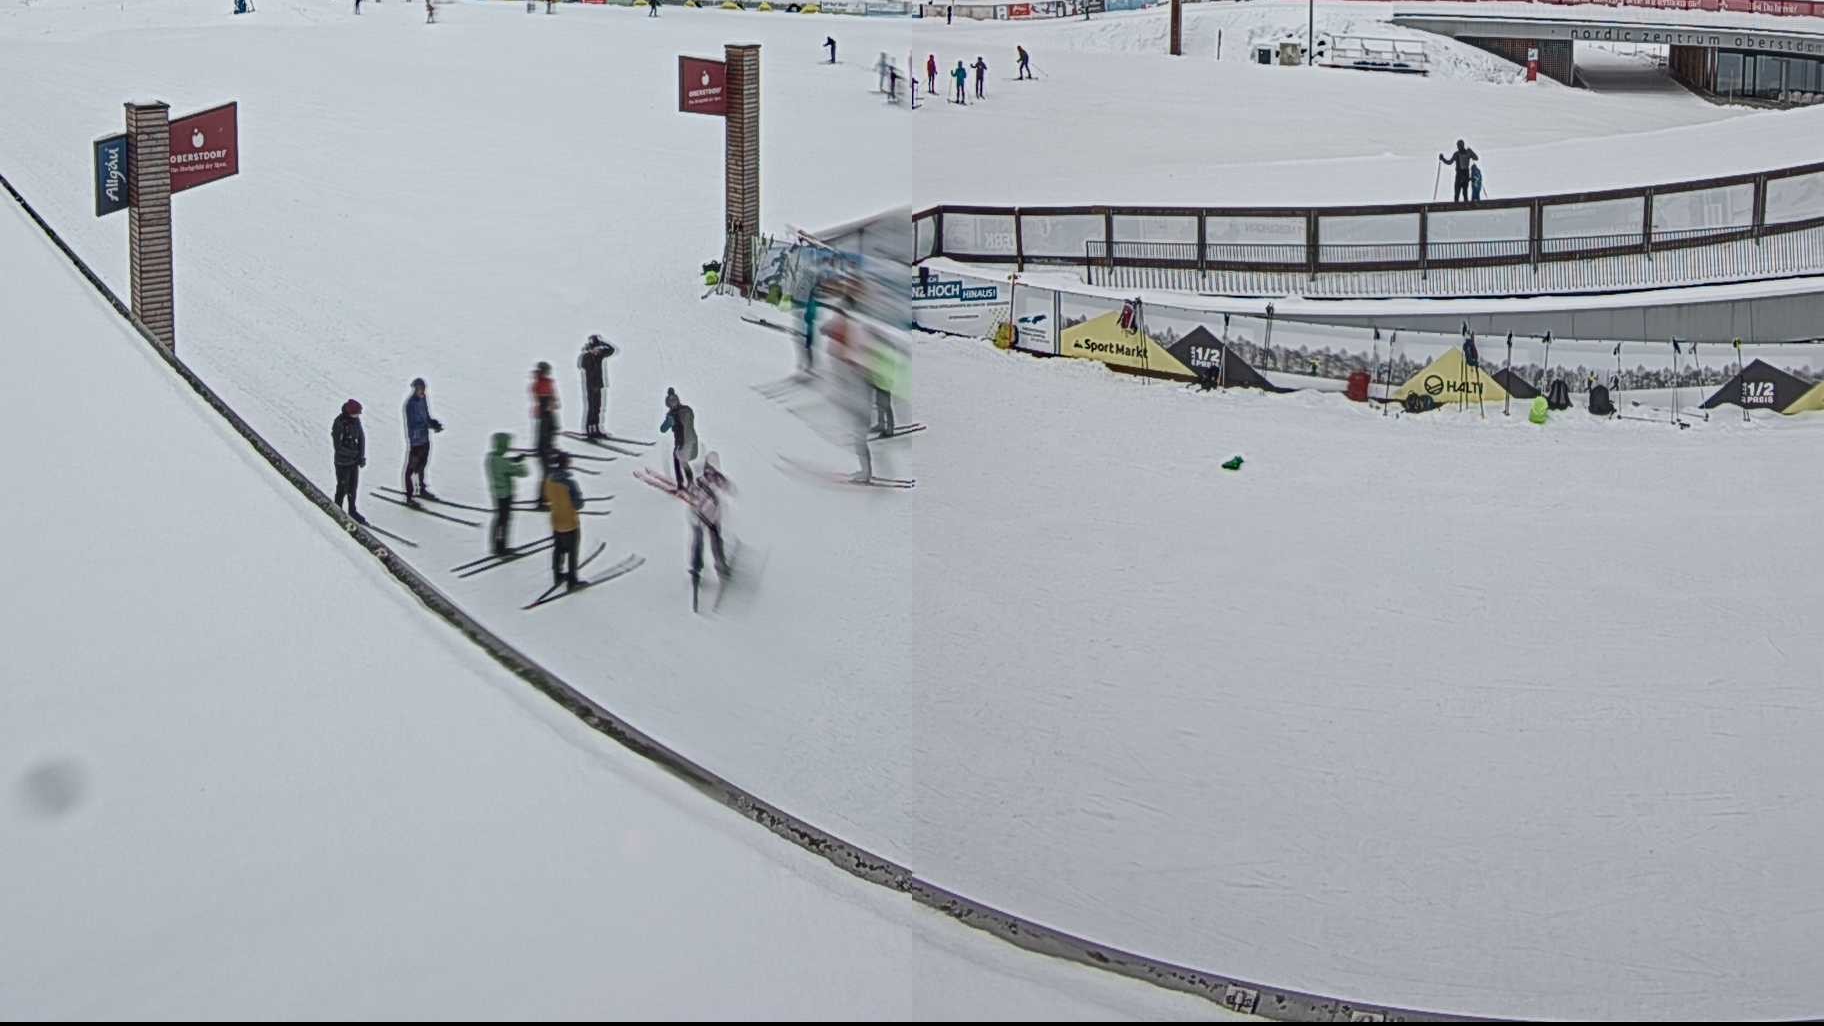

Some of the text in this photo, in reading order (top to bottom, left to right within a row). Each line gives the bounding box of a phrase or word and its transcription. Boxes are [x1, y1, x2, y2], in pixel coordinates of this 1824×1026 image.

[1571, 28, 1631, 41] nordic
[1643, 32, 1720, 46] zentrum
[170, 150, 227, 163] OBERSTDORF
[105, 147, 126, 202] Allgäu
[927, 284, 960, 297] HOCH
[962, 287, 996, 299] HINAUS!
[1196, 346, 1221, 362] 1/2
[1747, 382, 1775, 396] 1/2
